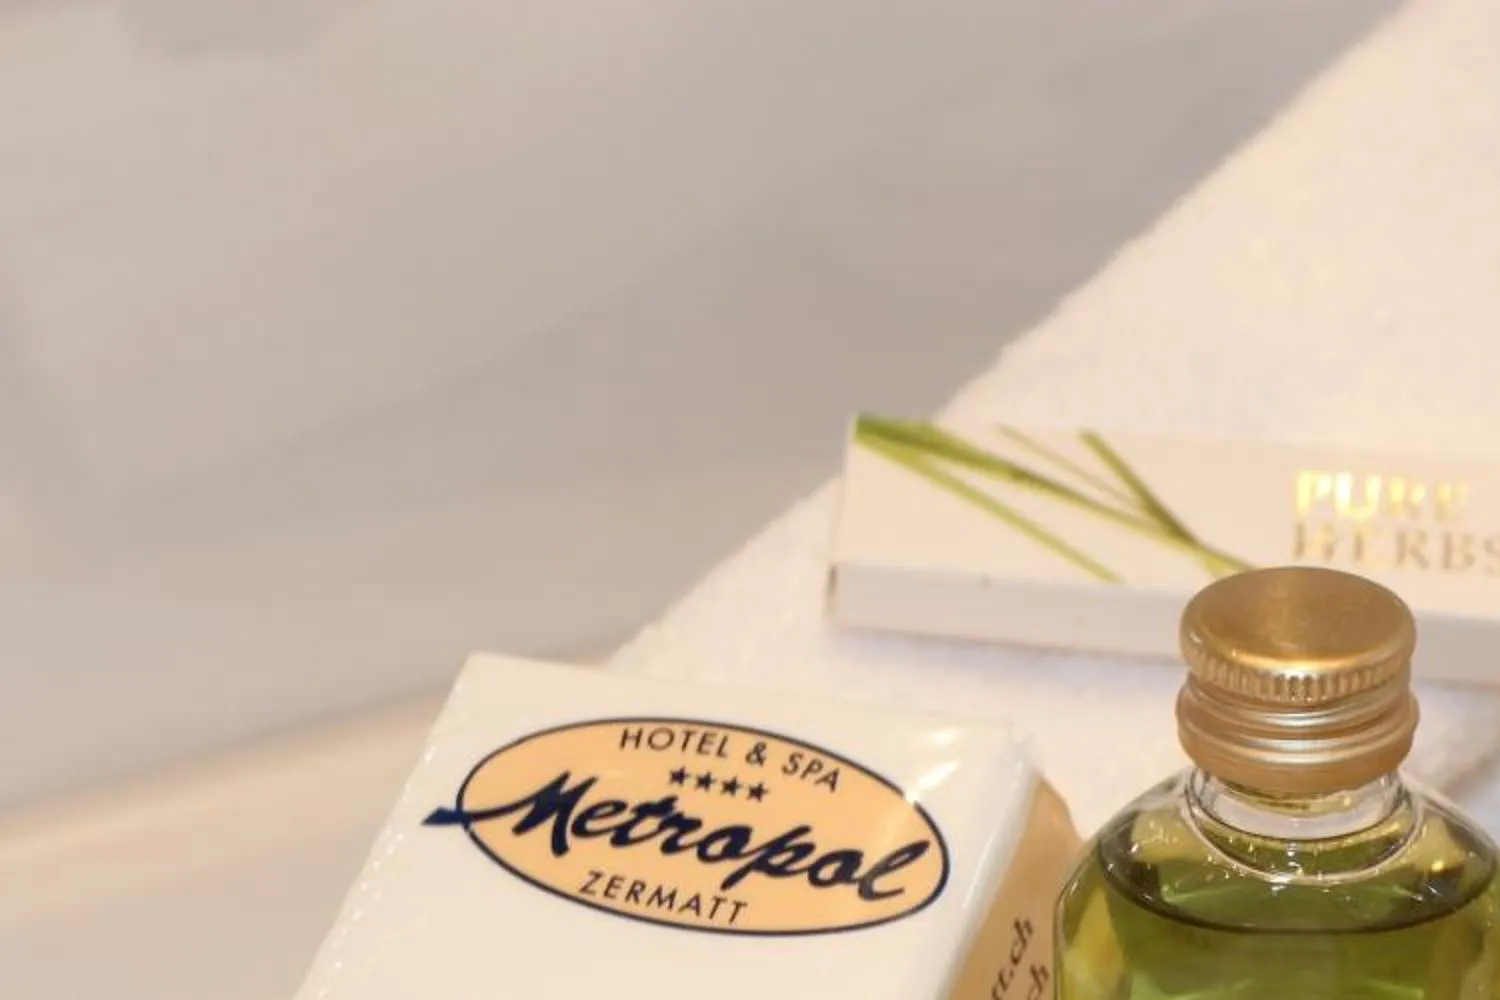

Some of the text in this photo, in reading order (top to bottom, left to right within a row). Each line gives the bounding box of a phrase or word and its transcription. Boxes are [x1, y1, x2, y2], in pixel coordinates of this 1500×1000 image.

[1296, 468, 1469, 522] PURE
[619, 727, 842, 793] HOTEL & SPA
[421, 770, 931, 901] Metropol
[579, 870, 748, 926] ZERMATT
